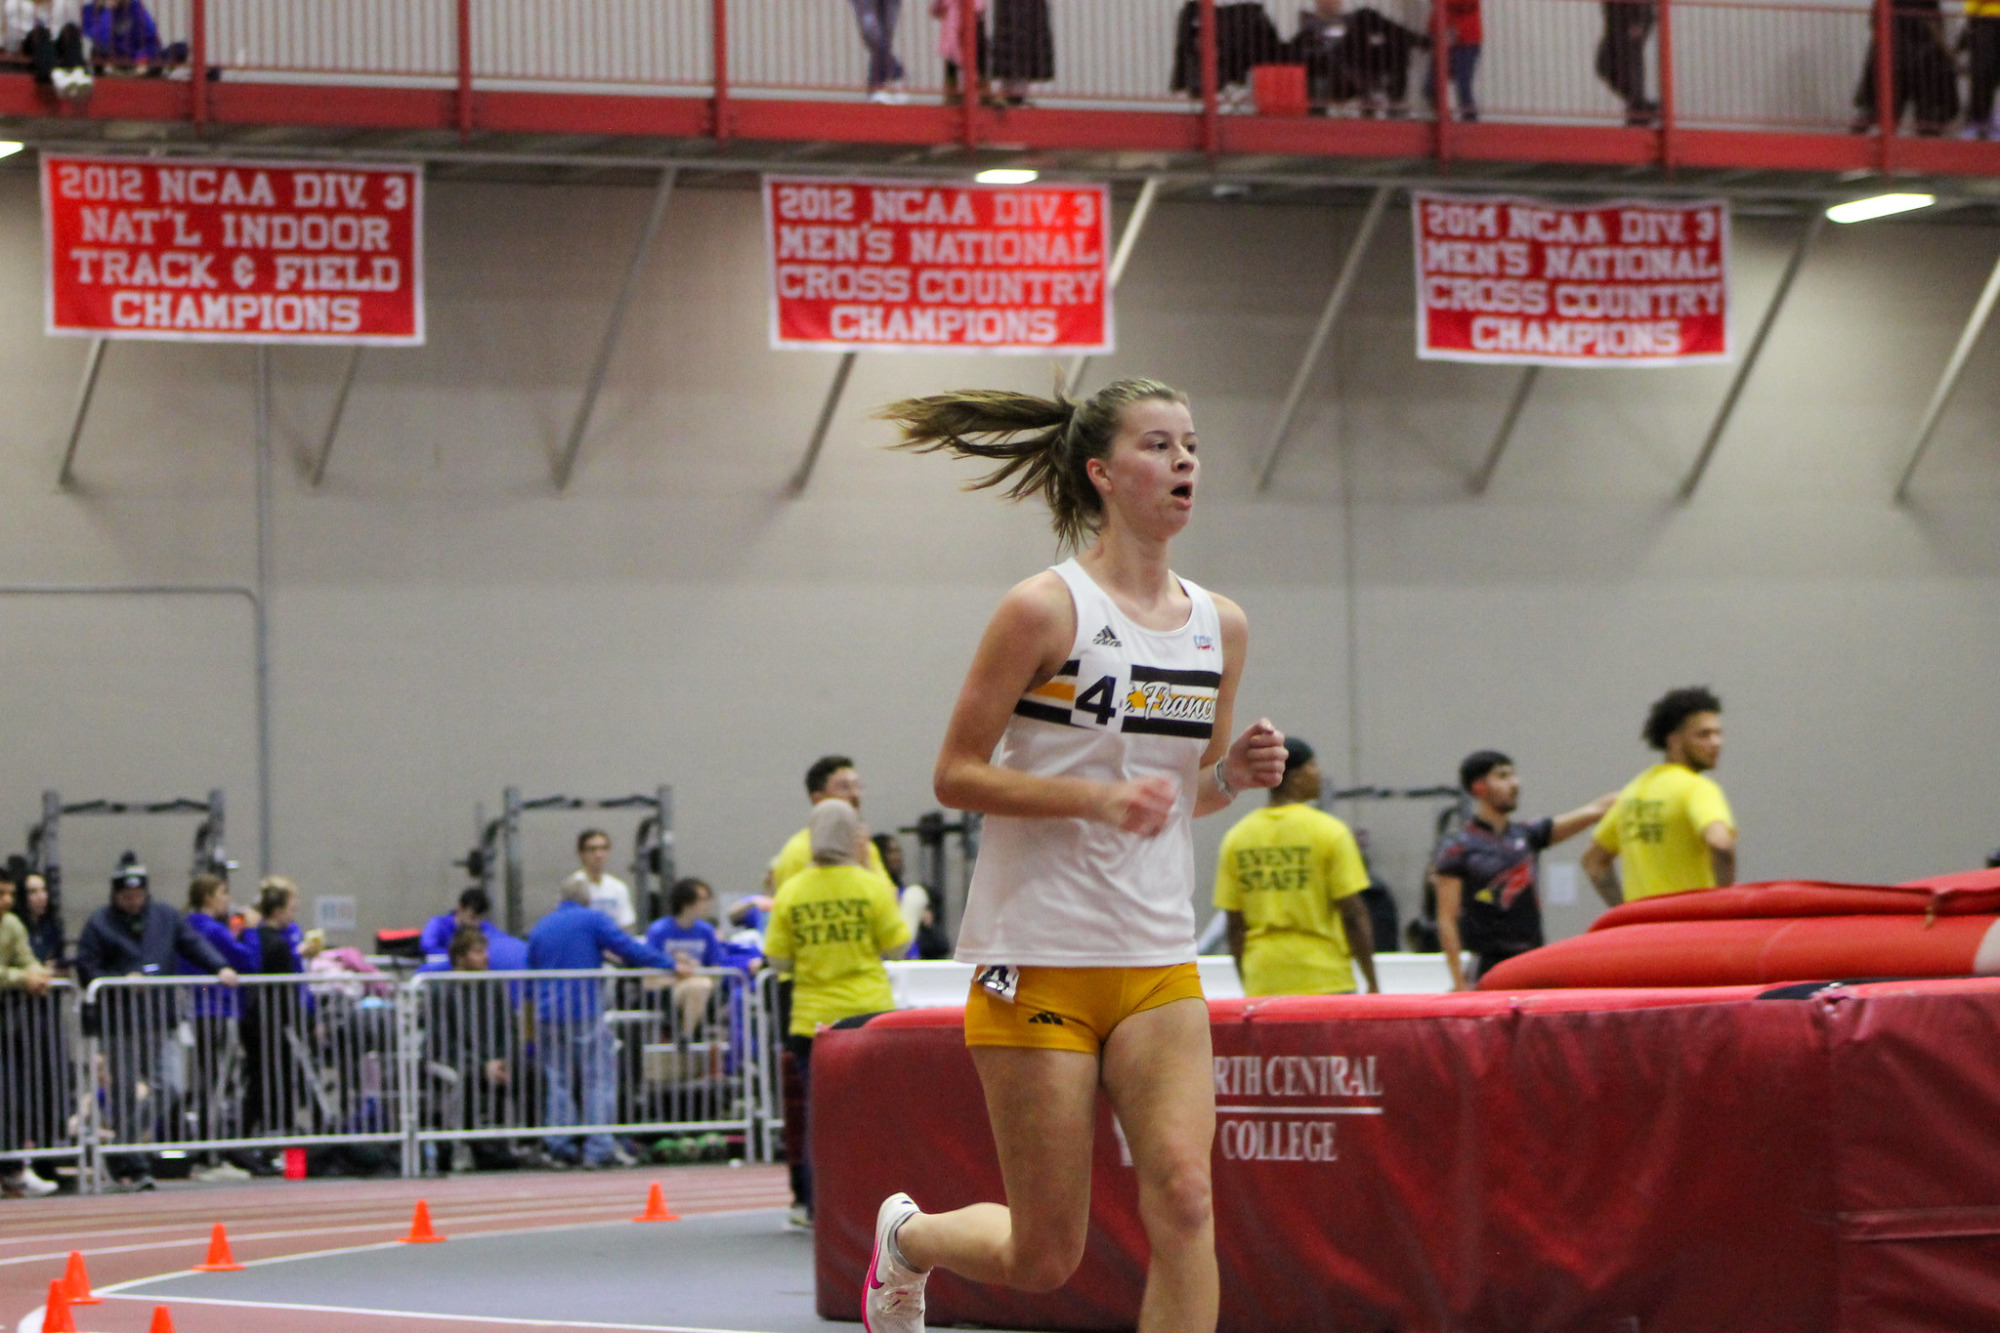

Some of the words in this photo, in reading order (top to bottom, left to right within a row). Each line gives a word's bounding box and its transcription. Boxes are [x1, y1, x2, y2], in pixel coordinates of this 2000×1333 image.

[60, 167, 142, 198] 2012
[159, 170, 275, 205] NCAA
[294, 175, 366, 207] DIV.
[384, 178, 407, 208] 3
[779, 188, 853, 221] 2012
[872, 193, 974, 224] NCAA
[994, 196, 1063, 224] DIV.
[1075, 197, 1094, 225] 3
[1509, 208, 1605, 241] NCAA
[1697, 213, 1715, 239] 3
[82, 210, 199, 245] NAT'L
[222, 216, 389, 250] INDOOR
[779, 224, 893, 260] MEN'S
[912, 231, 1099, 263] NATIONAL
[71, 251, 216, 286] TRACK
[233, 257, 254, 287] &
[275, 258, 399, 290] FIELD
[1427, 241, 1529, 274] MEN'S
[1545, 247, 1718, 278] NATIONAL
[778, 268, 909, 300] CROSS
[918, 272, 1100, 302] COUNTRY
[1429, 279, 1547, 313] CROSS
[1555, 285, 1720, 316] COUNTRY
[112, 293, 360, 330] CHAMPIONS
[831, 307, 1057, 341] CHAMPIONS
[1473, 319, 1680, 352] CHAMPIONS
[1075, 675, 1117, 725] 4
[1237, 846, 1311, 869] EVENT
[791, 899, 871, 923] EVENT
[793, 922, 866, 947] STAFF
[1213, 1056, 1262, 1095] RTH
[1265, 1056, 1384, 1096] CENTRAL
[1221, 1120, 1338, 1161] COLLEGE
